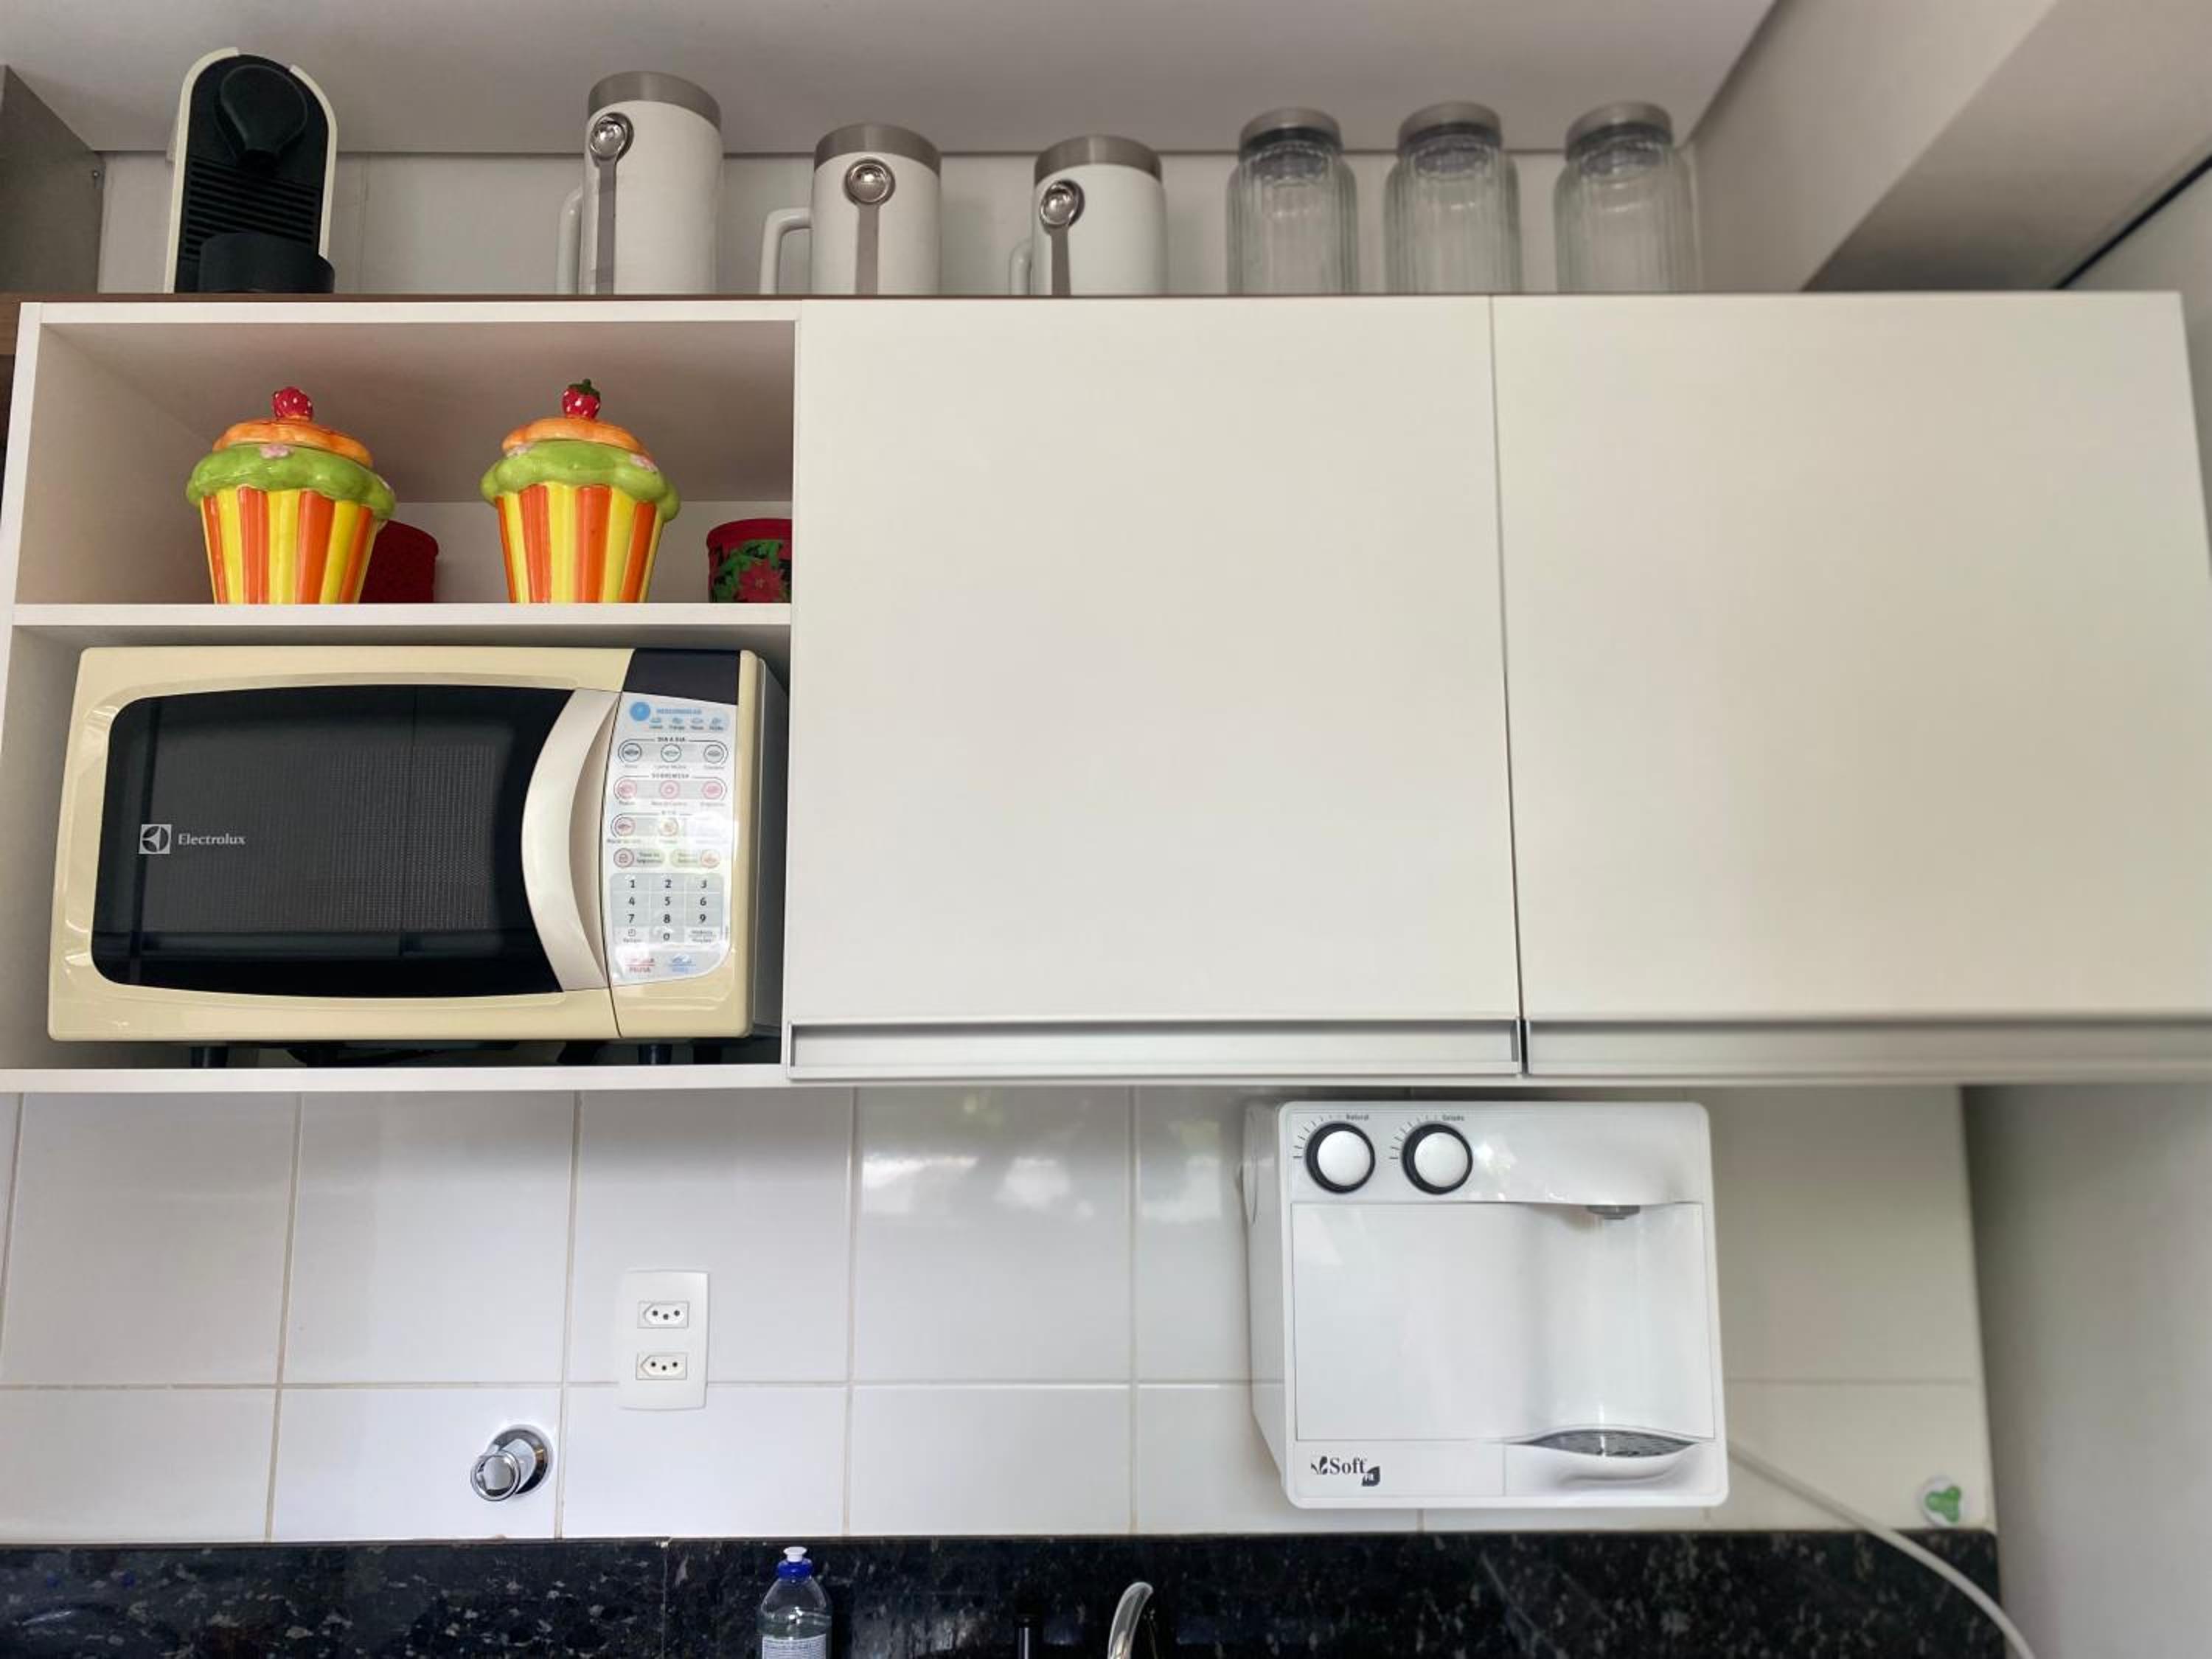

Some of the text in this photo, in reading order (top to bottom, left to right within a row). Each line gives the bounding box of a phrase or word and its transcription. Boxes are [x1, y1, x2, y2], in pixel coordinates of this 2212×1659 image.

[178, 832, 246, 845] Electrolux
[630, 880, 707, 888] 1 2 3
[628, 897, 707, 906] 4 5 6
[628, 914, 706, 924] 7 8 9
[663, 933, 670, 942] 0
[1329, 1456, 1366, 1475] Soft
